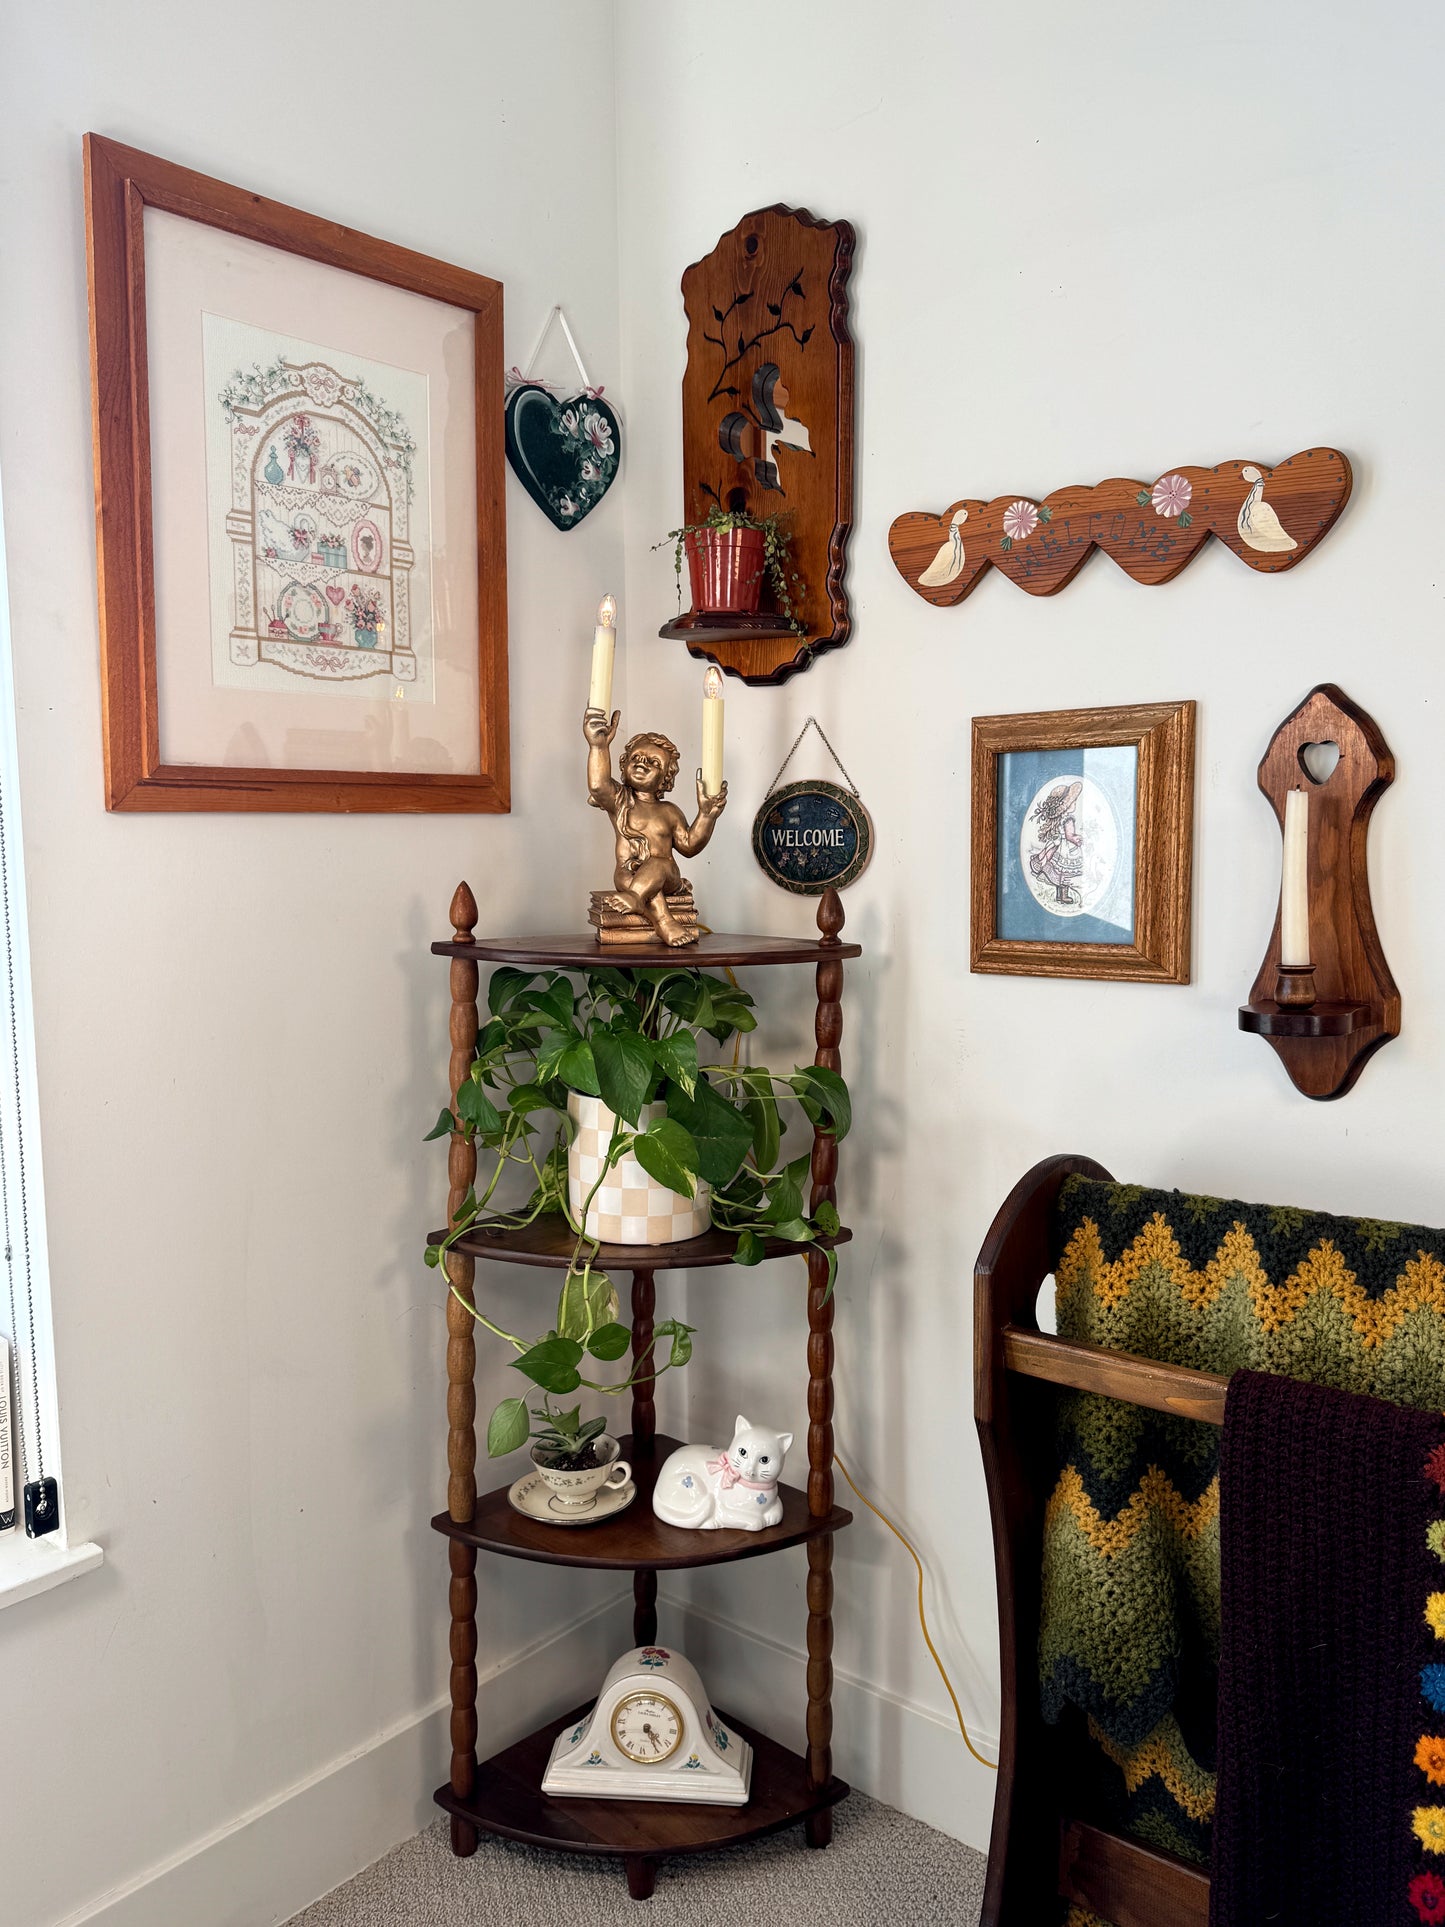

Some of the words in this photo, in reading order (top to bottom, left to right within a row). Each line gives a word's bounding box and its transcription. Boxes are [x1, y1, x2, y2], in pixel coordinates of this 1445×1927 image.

[1015, 513, 1177, 576] WELCOME
[771, 828, 845, 847] WELCOME
[0, 1426, 10, 1470] VUITTON
